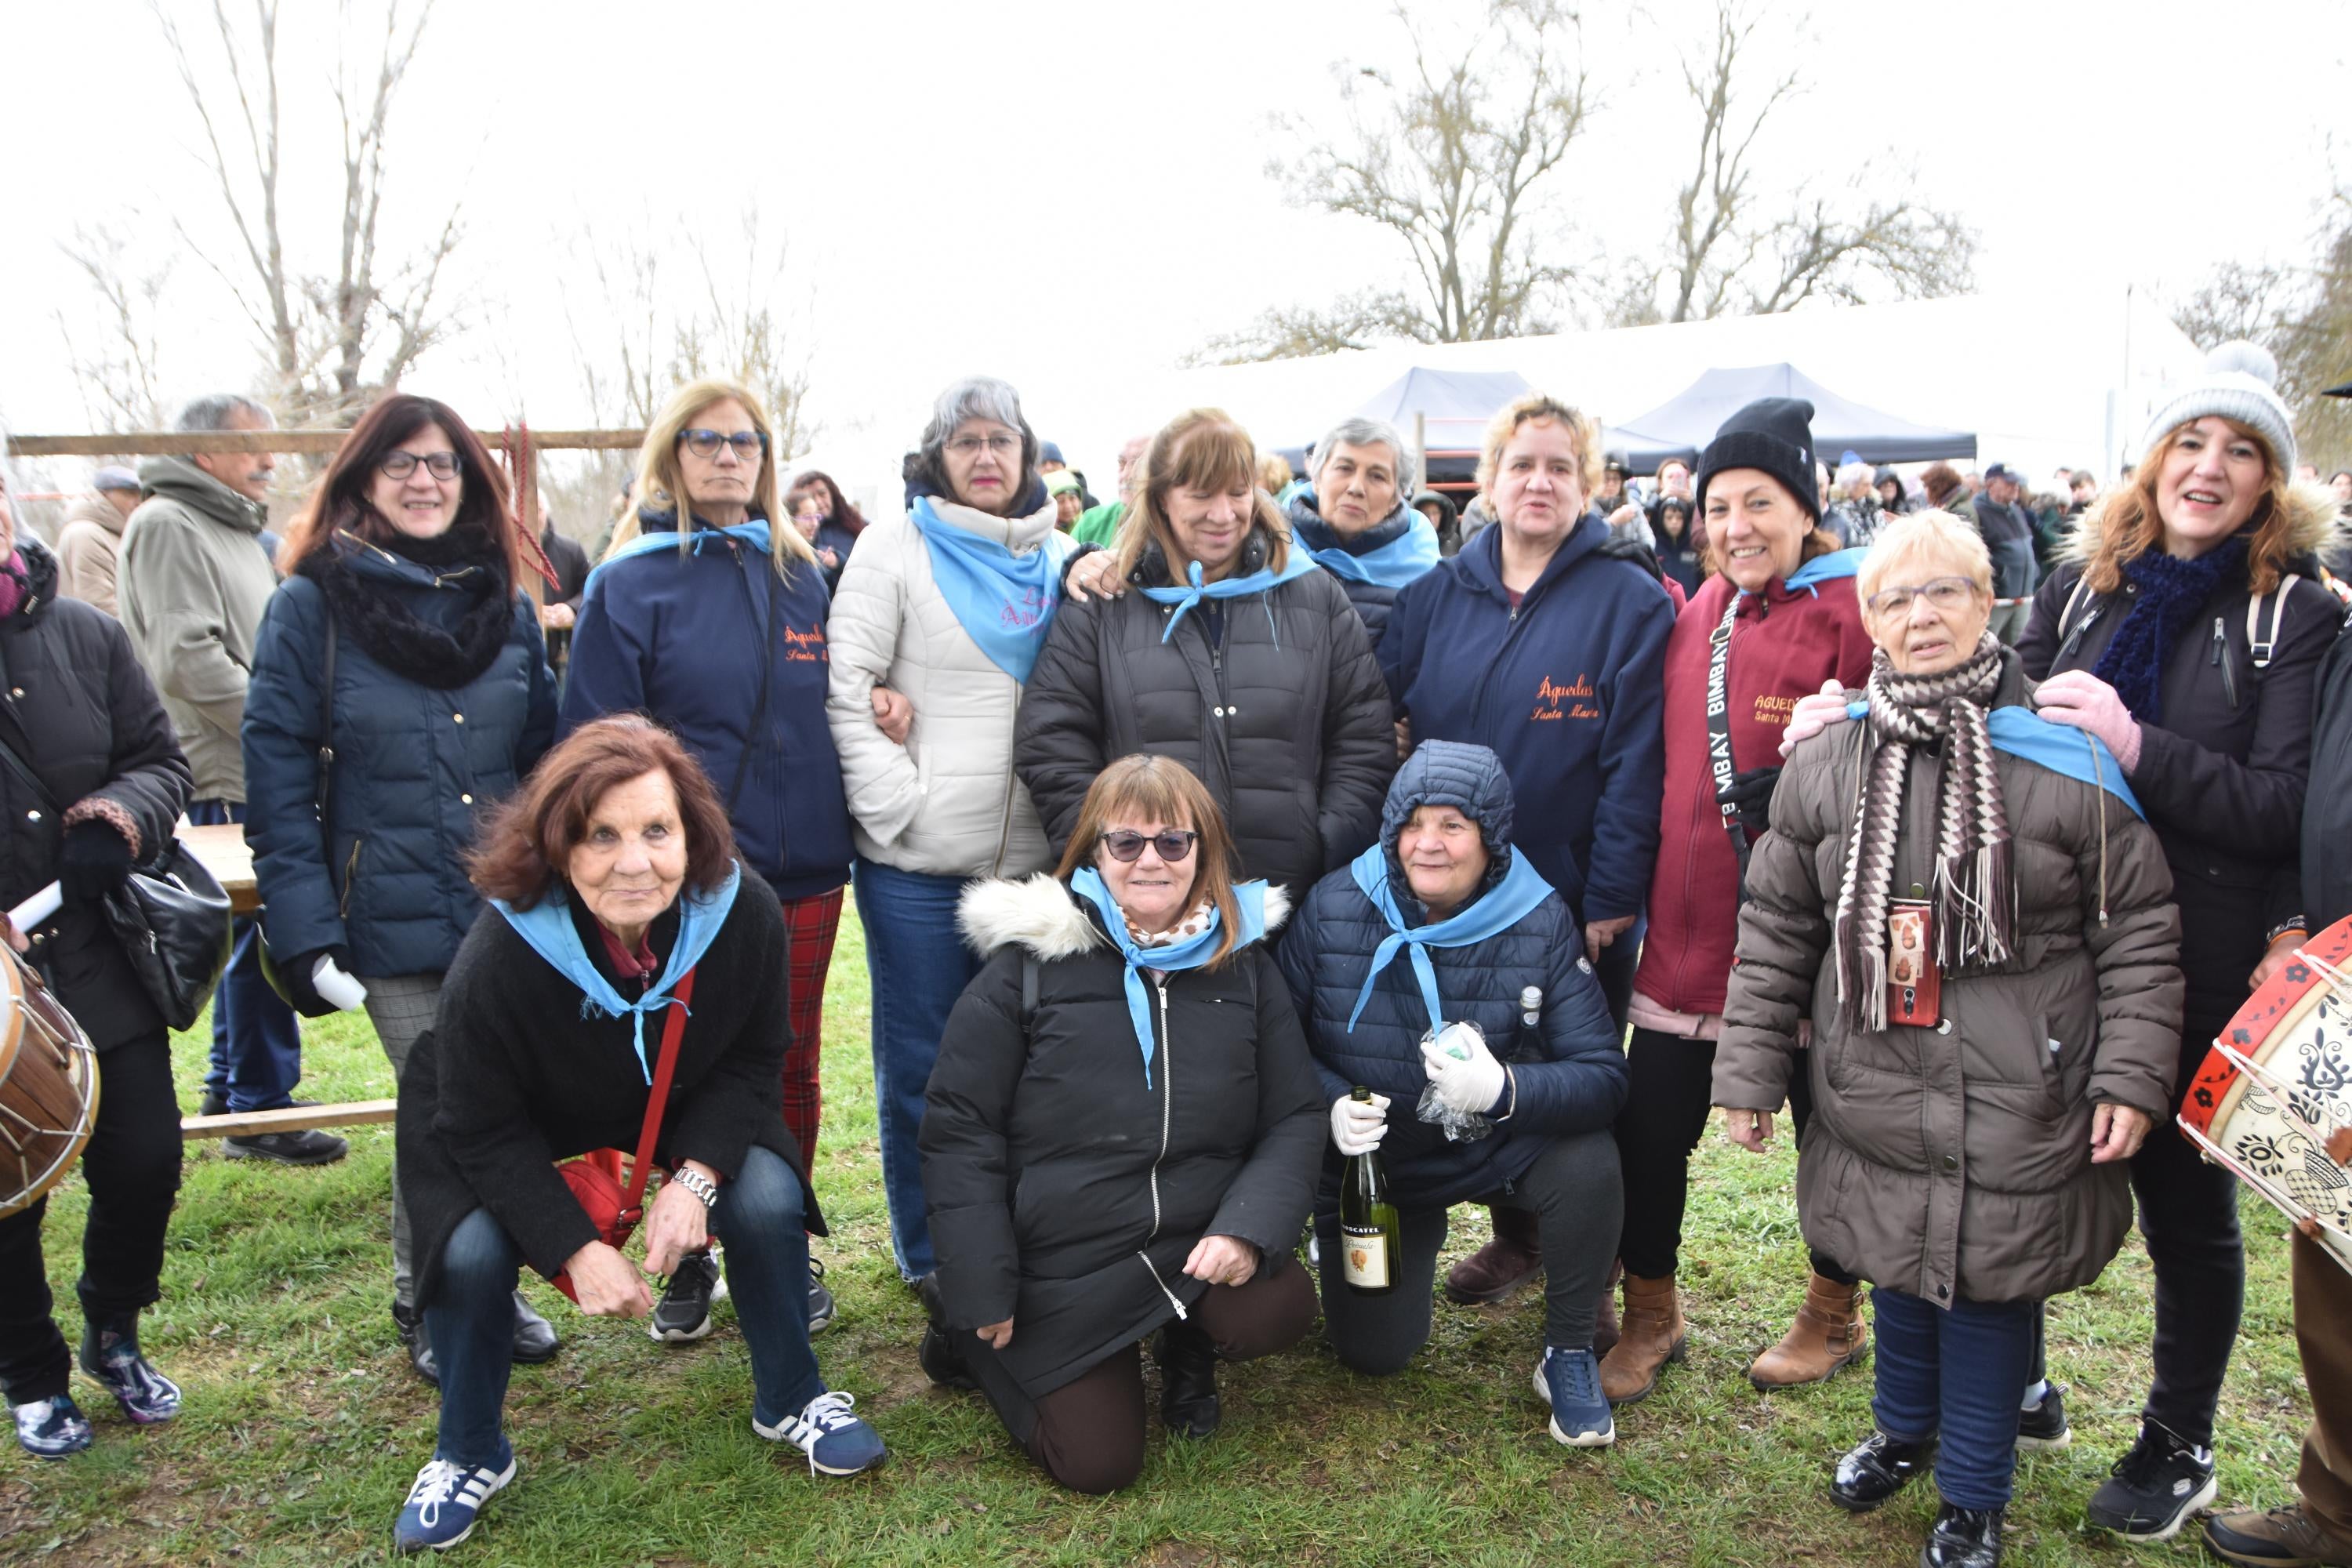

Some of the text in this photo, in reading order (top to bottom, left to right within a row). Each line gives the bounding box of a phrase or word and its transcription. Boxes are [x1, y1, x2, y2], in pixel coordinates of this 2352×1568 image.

[786, 648, 816, 660] Santa
[1708, 641, 1729, 717] BIMBAY
[1537, 673, 1593, 706] Águedas
[1755, 695, 1798, 710] AGUED
[1530, 706, 1563, 720] Santa
[1755, 710, 1780, 722] Santa
